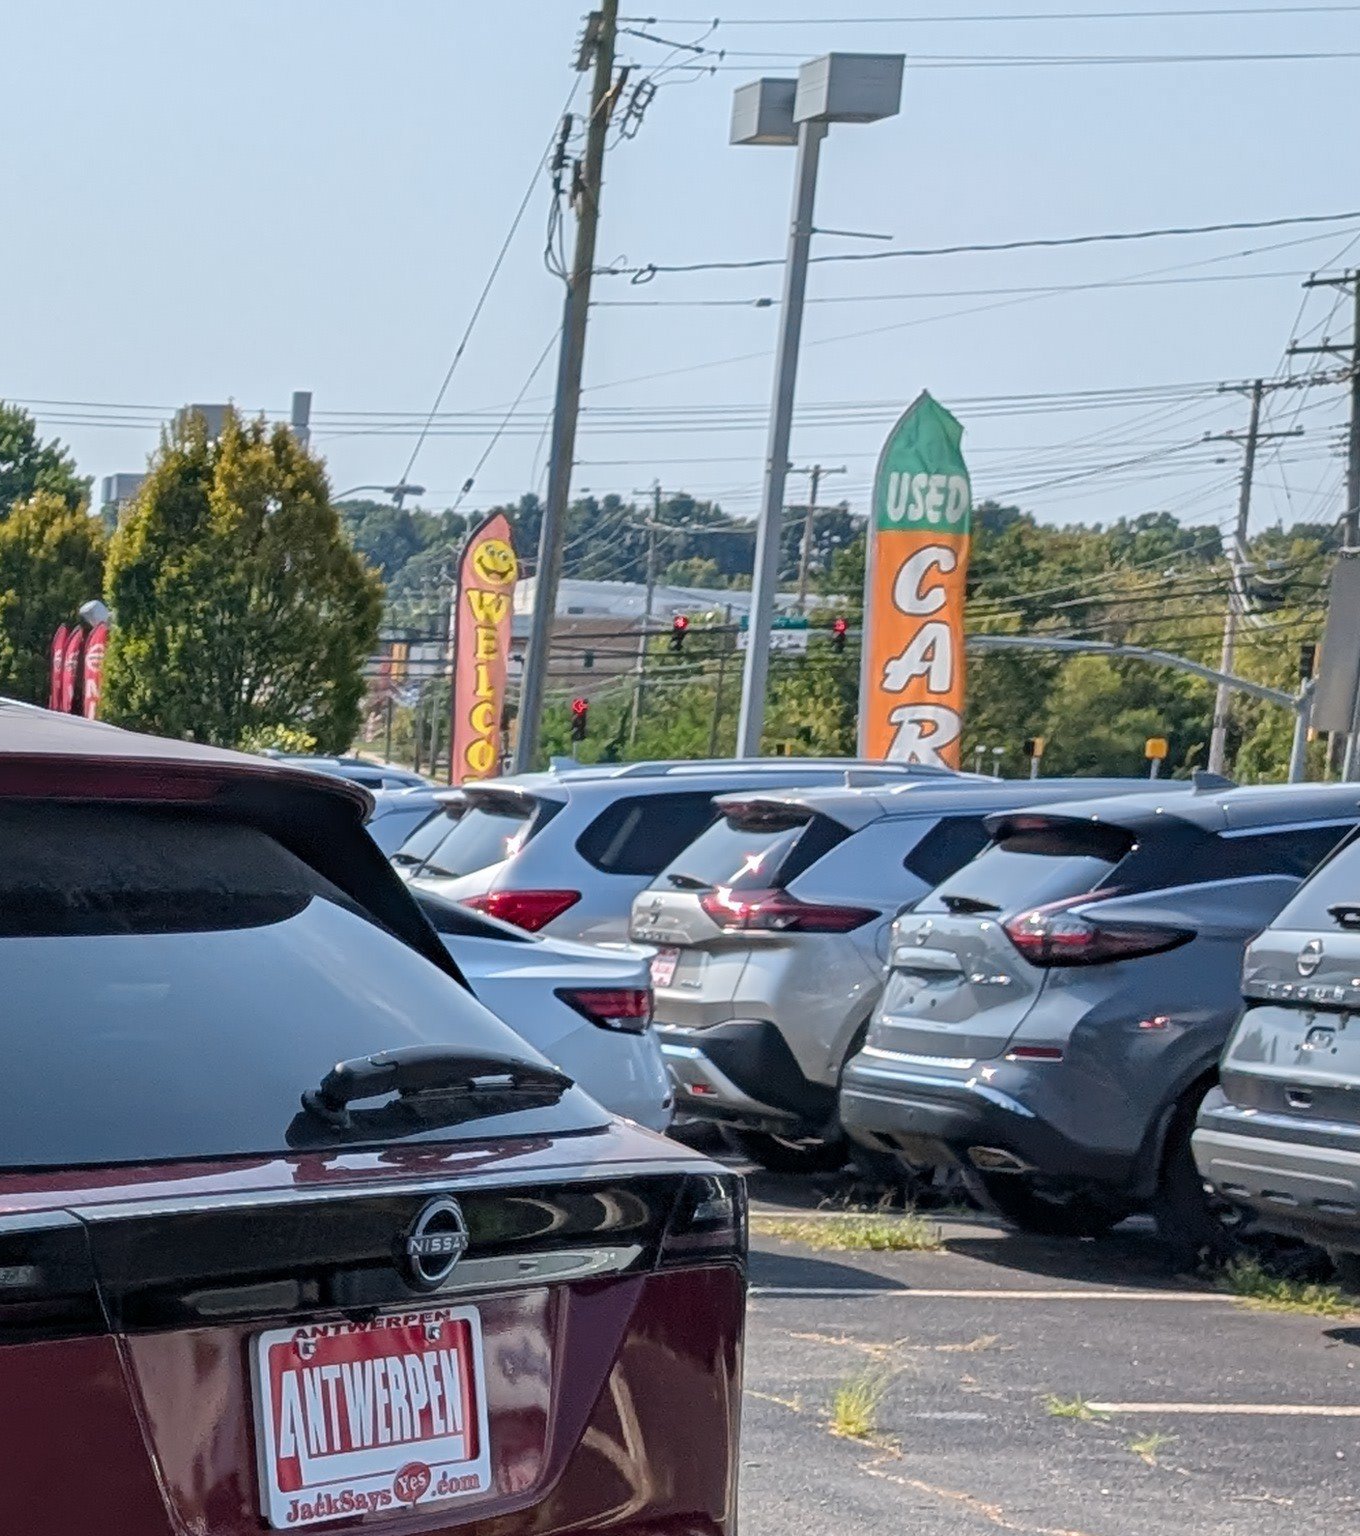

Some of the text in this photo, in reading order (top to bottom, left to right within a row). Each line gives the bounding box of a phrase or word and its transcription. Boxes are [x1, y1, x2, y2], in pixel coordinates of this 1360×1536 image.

[886, 471, 970, 524] USED
[462, 587, 512, 783] WELCO
[881, 543, 962, 770] CAR
[293, 1309, 452, 1341] ANTWERPEN
[279, 1347, 464, 1459] ANTWERPEN
